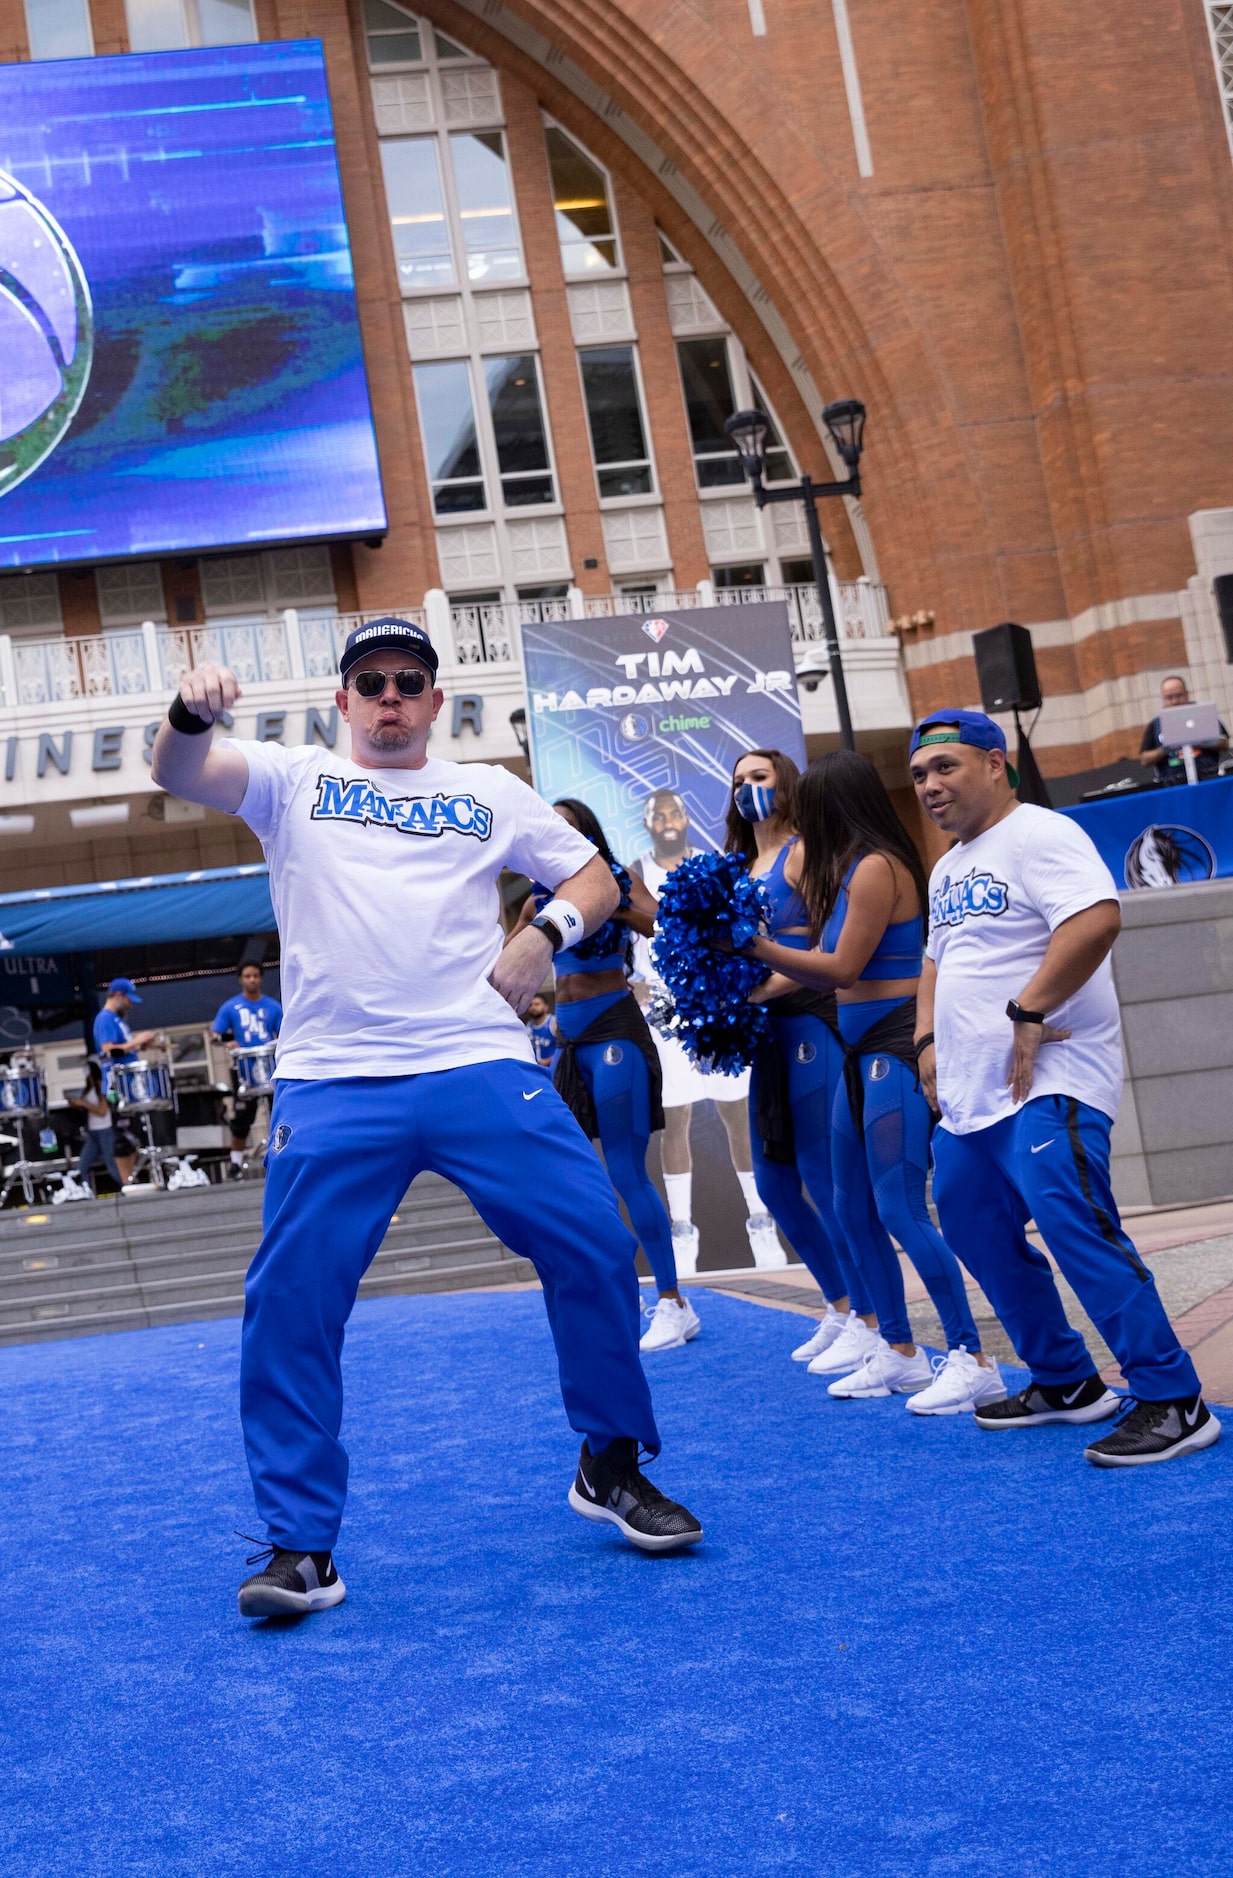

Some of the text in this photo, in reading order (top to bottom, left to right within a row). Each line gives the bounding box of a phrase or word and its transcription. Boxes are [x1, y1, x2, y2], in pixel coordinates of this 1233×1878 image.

[615, 648, 705, 680] TIM
[533, 670, 794, 713] HARDAWAY JR
[659, 715, 709, 733] chime
[3, 955, 59, 976] ULTRA
